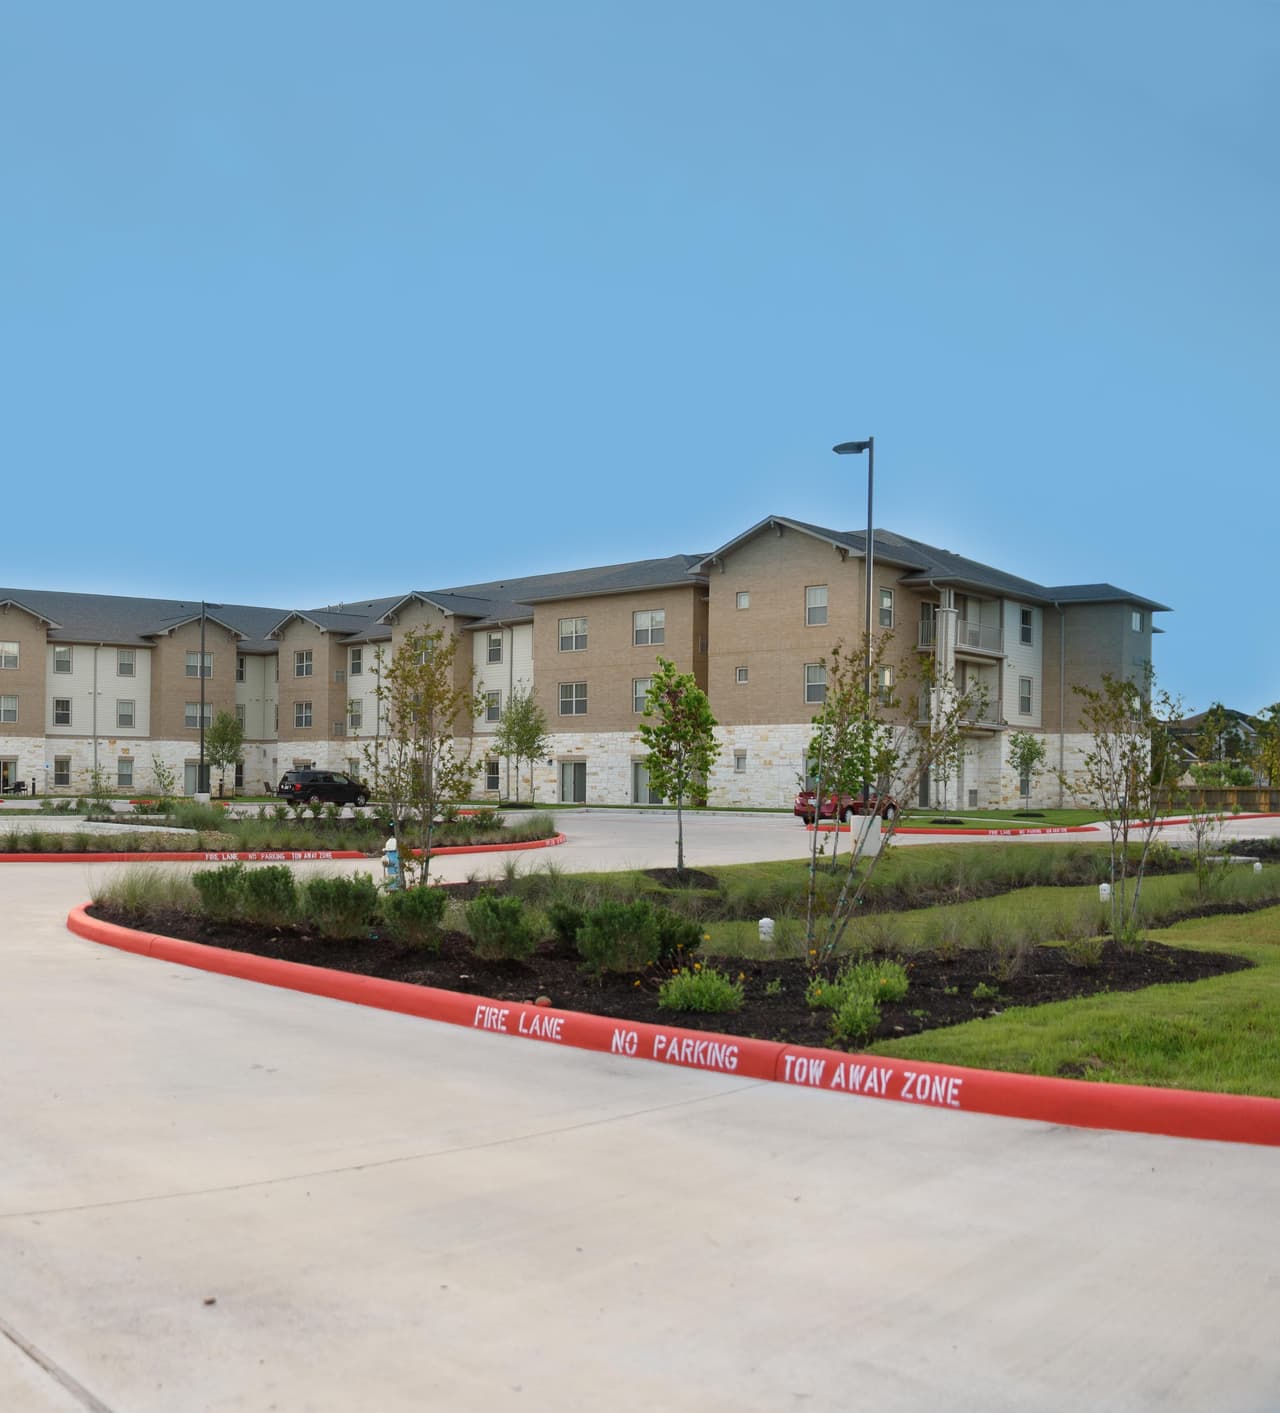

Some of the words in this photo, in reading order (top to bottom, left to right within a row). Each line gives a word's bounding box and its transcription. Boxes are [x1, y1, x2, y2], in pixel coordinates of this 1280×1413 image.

[474, 1004, 510, 1032] FIRE
[518, 1011, 565, 1041] LANE
[611, 1028, 638, 1055] NO
[653, 1034, 739, 1071] PARKING
[784, 1055, 826, 1086] TOW
[830, 1062, 894, 1096] AWAY
[900, 1071, 964, 1107] ZONE
